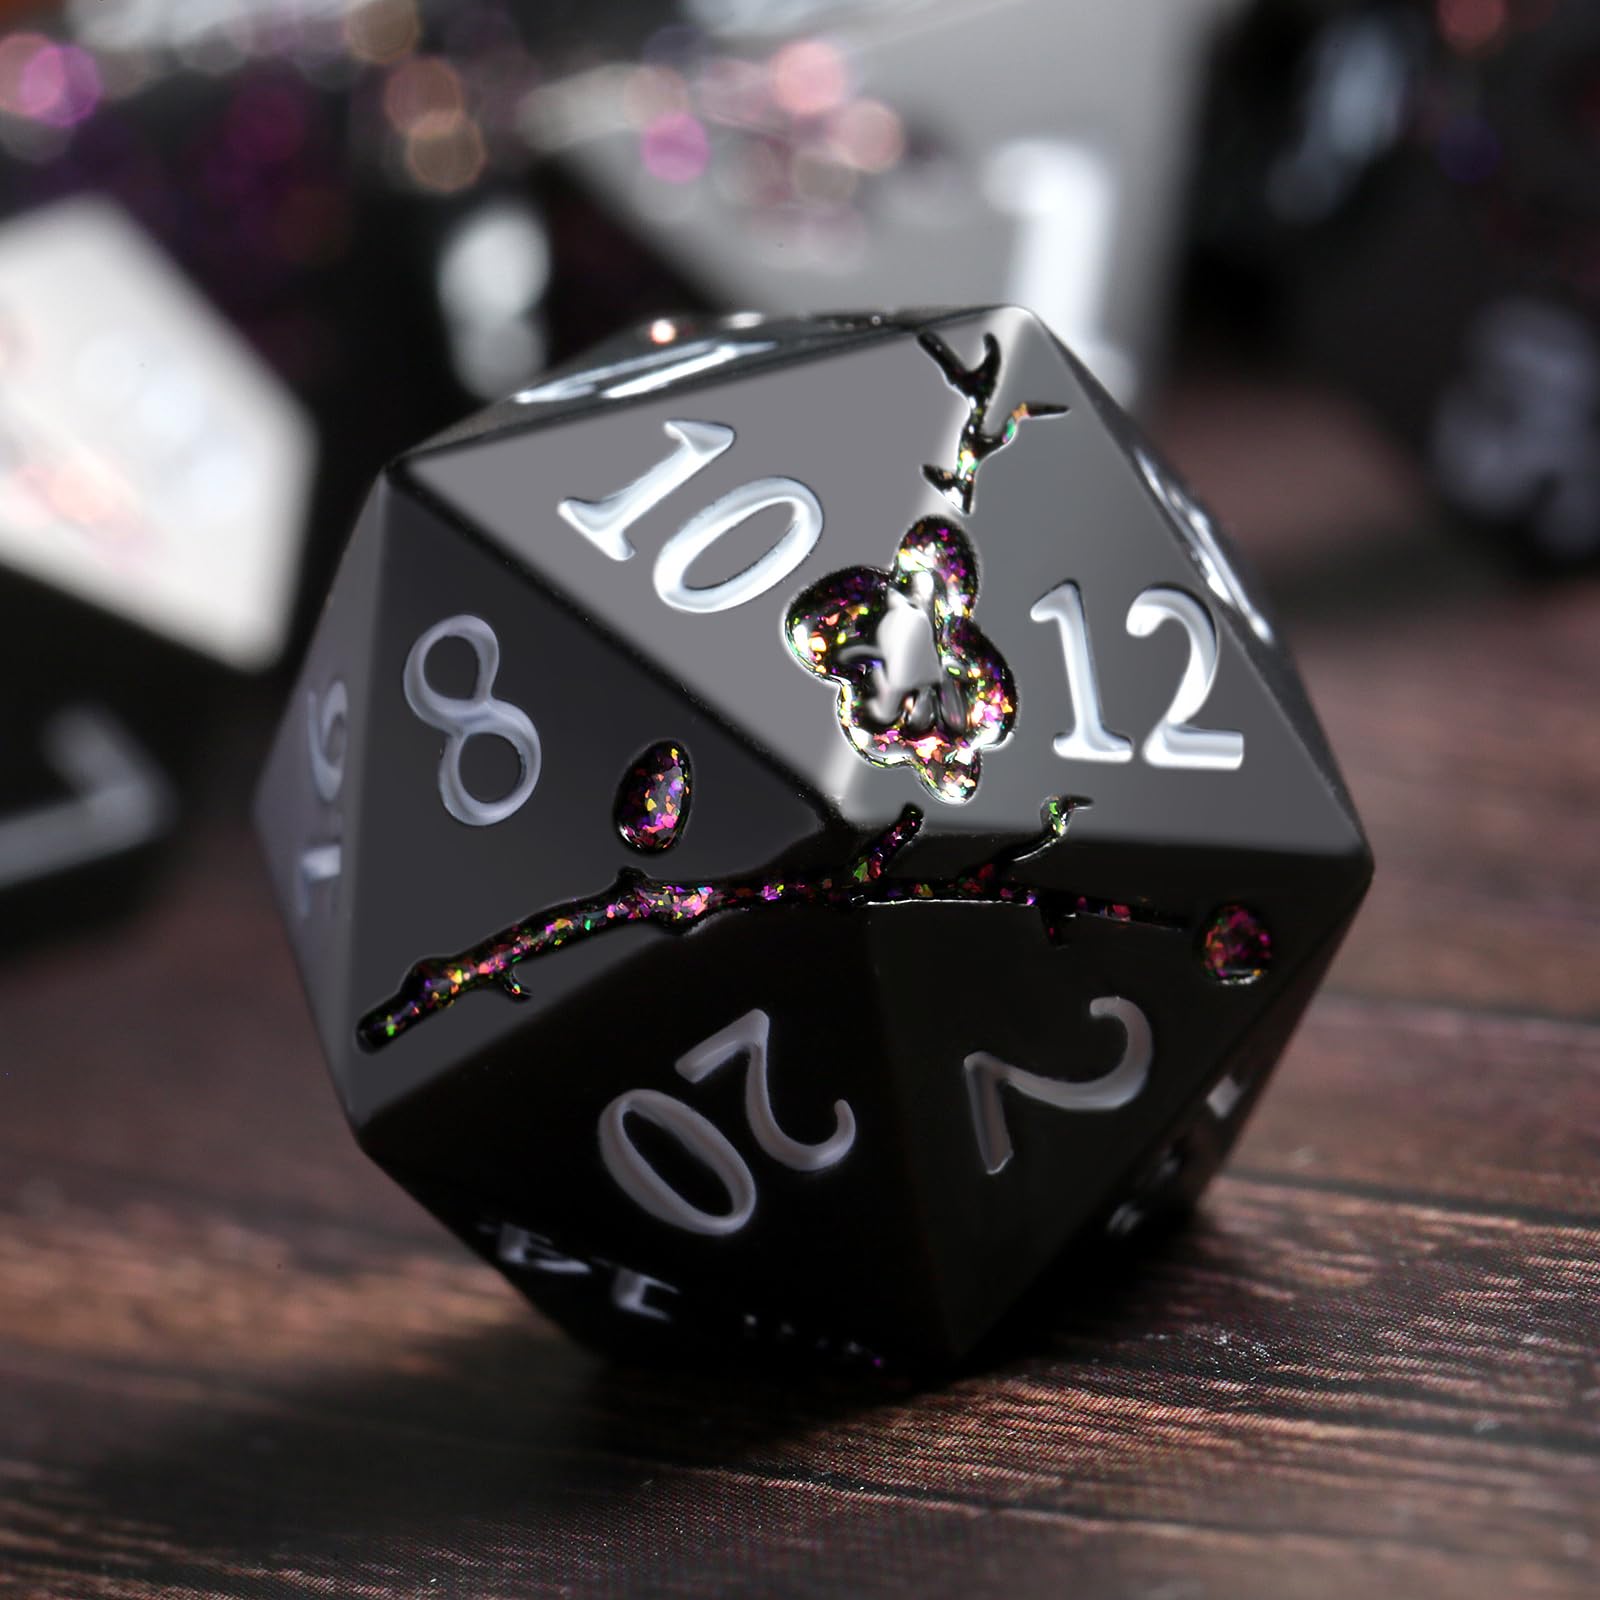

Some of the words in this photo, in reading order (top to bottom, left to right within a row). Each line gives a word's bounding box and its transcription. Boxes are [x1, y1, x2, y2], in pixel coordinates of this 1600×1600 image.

[557, 418, 824, 615] 10
[403, 613, 542, 826] 8
[1030, 580, 1246, 771] 12
[596, 1008, 857, 1237] 20
[963, 995, 1154, 1176] 2
